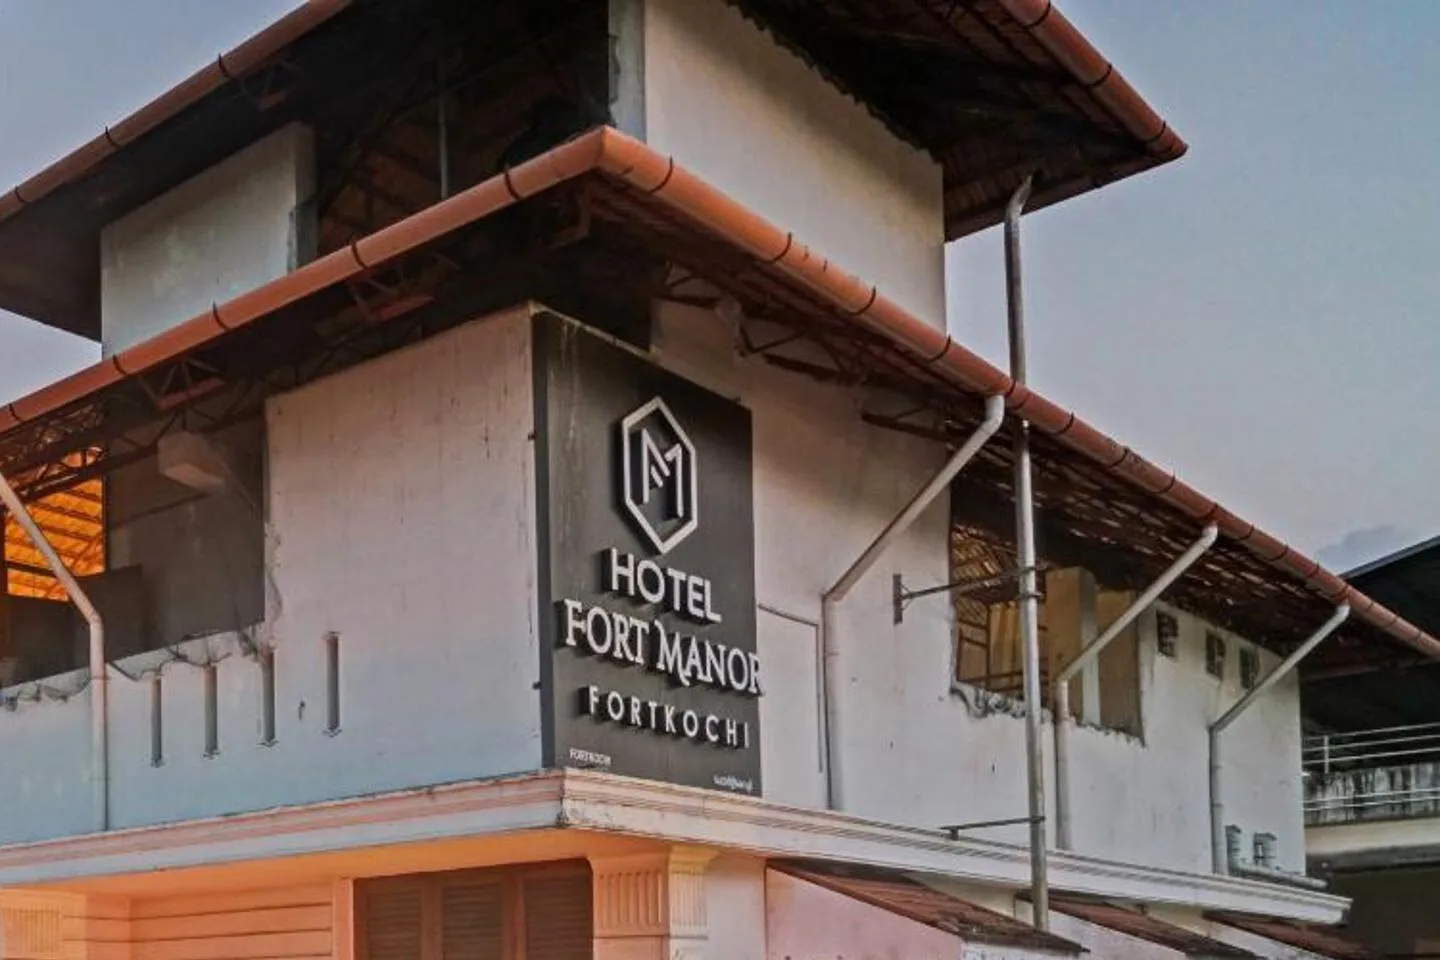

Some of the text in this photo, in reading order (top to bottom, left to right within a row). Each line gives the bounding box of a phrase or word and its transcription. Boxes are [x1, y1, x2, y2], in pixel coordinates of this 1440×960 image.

[611, 547, 722, 623] HOTEL
[564, 598, 763, 695] FORT MANOR
[588, 684, 750, 749] FORTKOCHI
